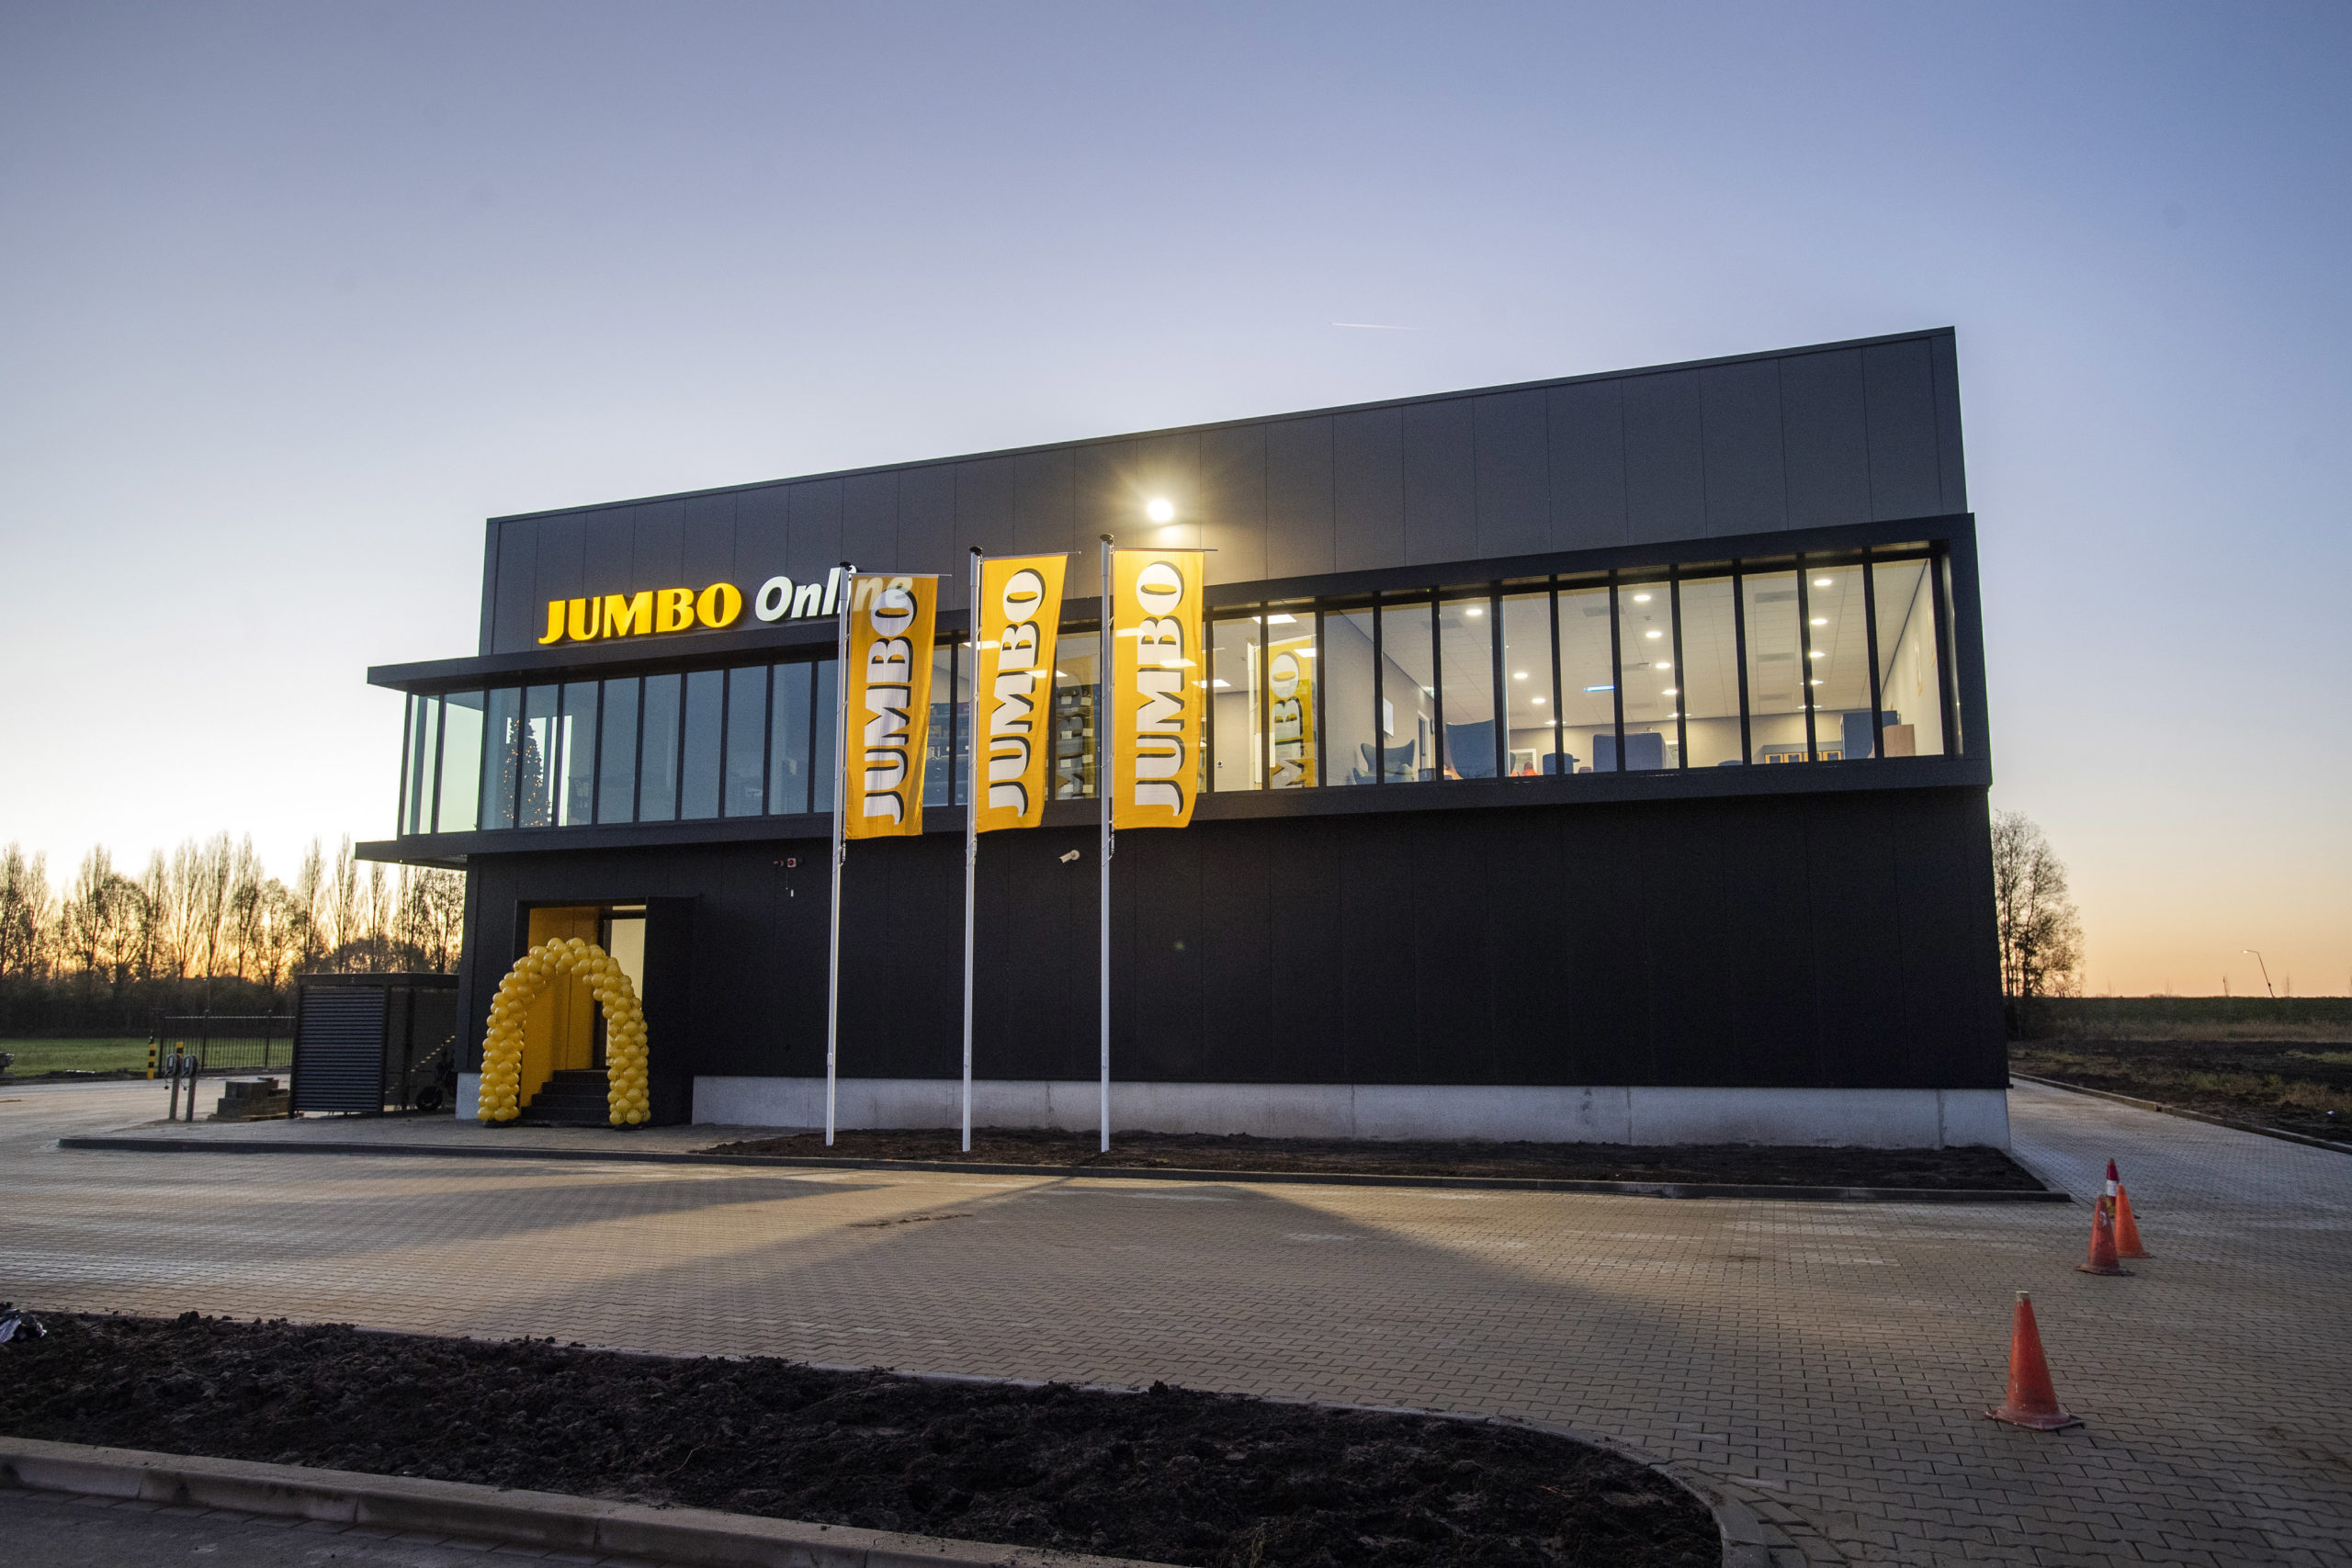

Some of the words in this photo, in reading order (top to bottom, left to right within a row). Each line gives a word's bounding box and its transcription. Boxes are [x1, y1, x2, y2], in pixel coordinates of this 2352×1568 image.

[538, 582, 742, 645] JUMBO
[864, 586, 917, 825] JUMBO
[989, 568, 1046, 818] JUMBO
[1135, 561, 1186, 817] JUMBO
